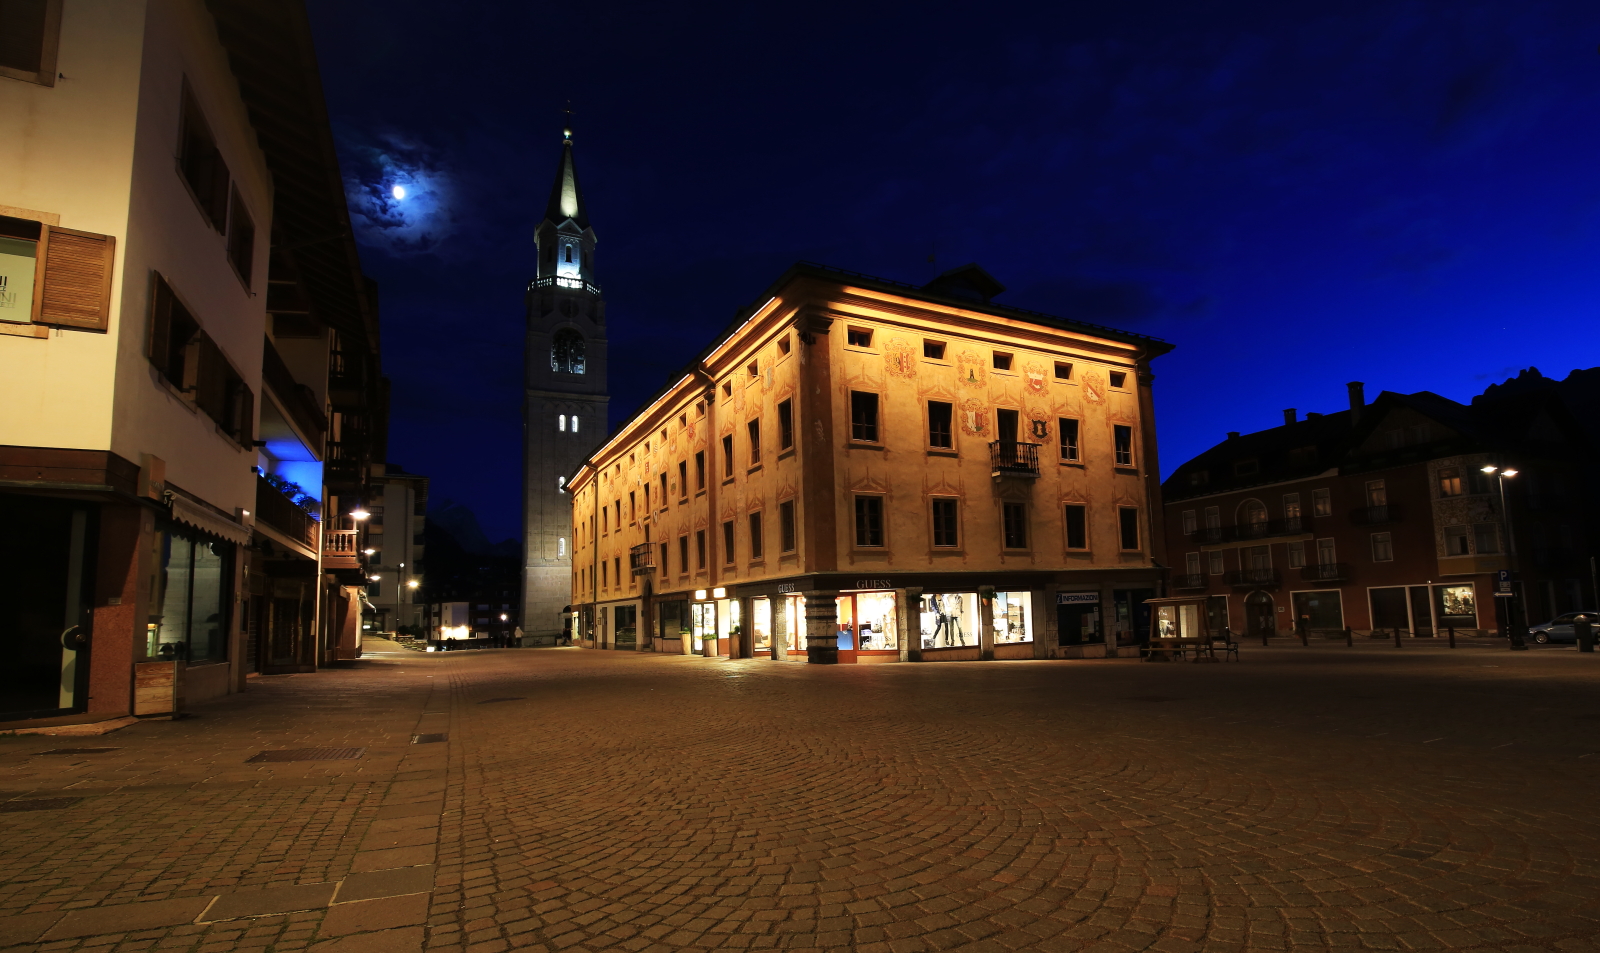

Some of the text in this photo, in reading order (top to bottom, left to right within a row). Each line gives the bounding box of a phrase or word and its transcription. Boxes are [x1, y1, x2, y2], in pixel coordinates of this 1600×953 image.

[1500, 571, 1507, 580] P
[778, 583, 795, 593] GUESS
[857, 579, 891, 589] GUESS
